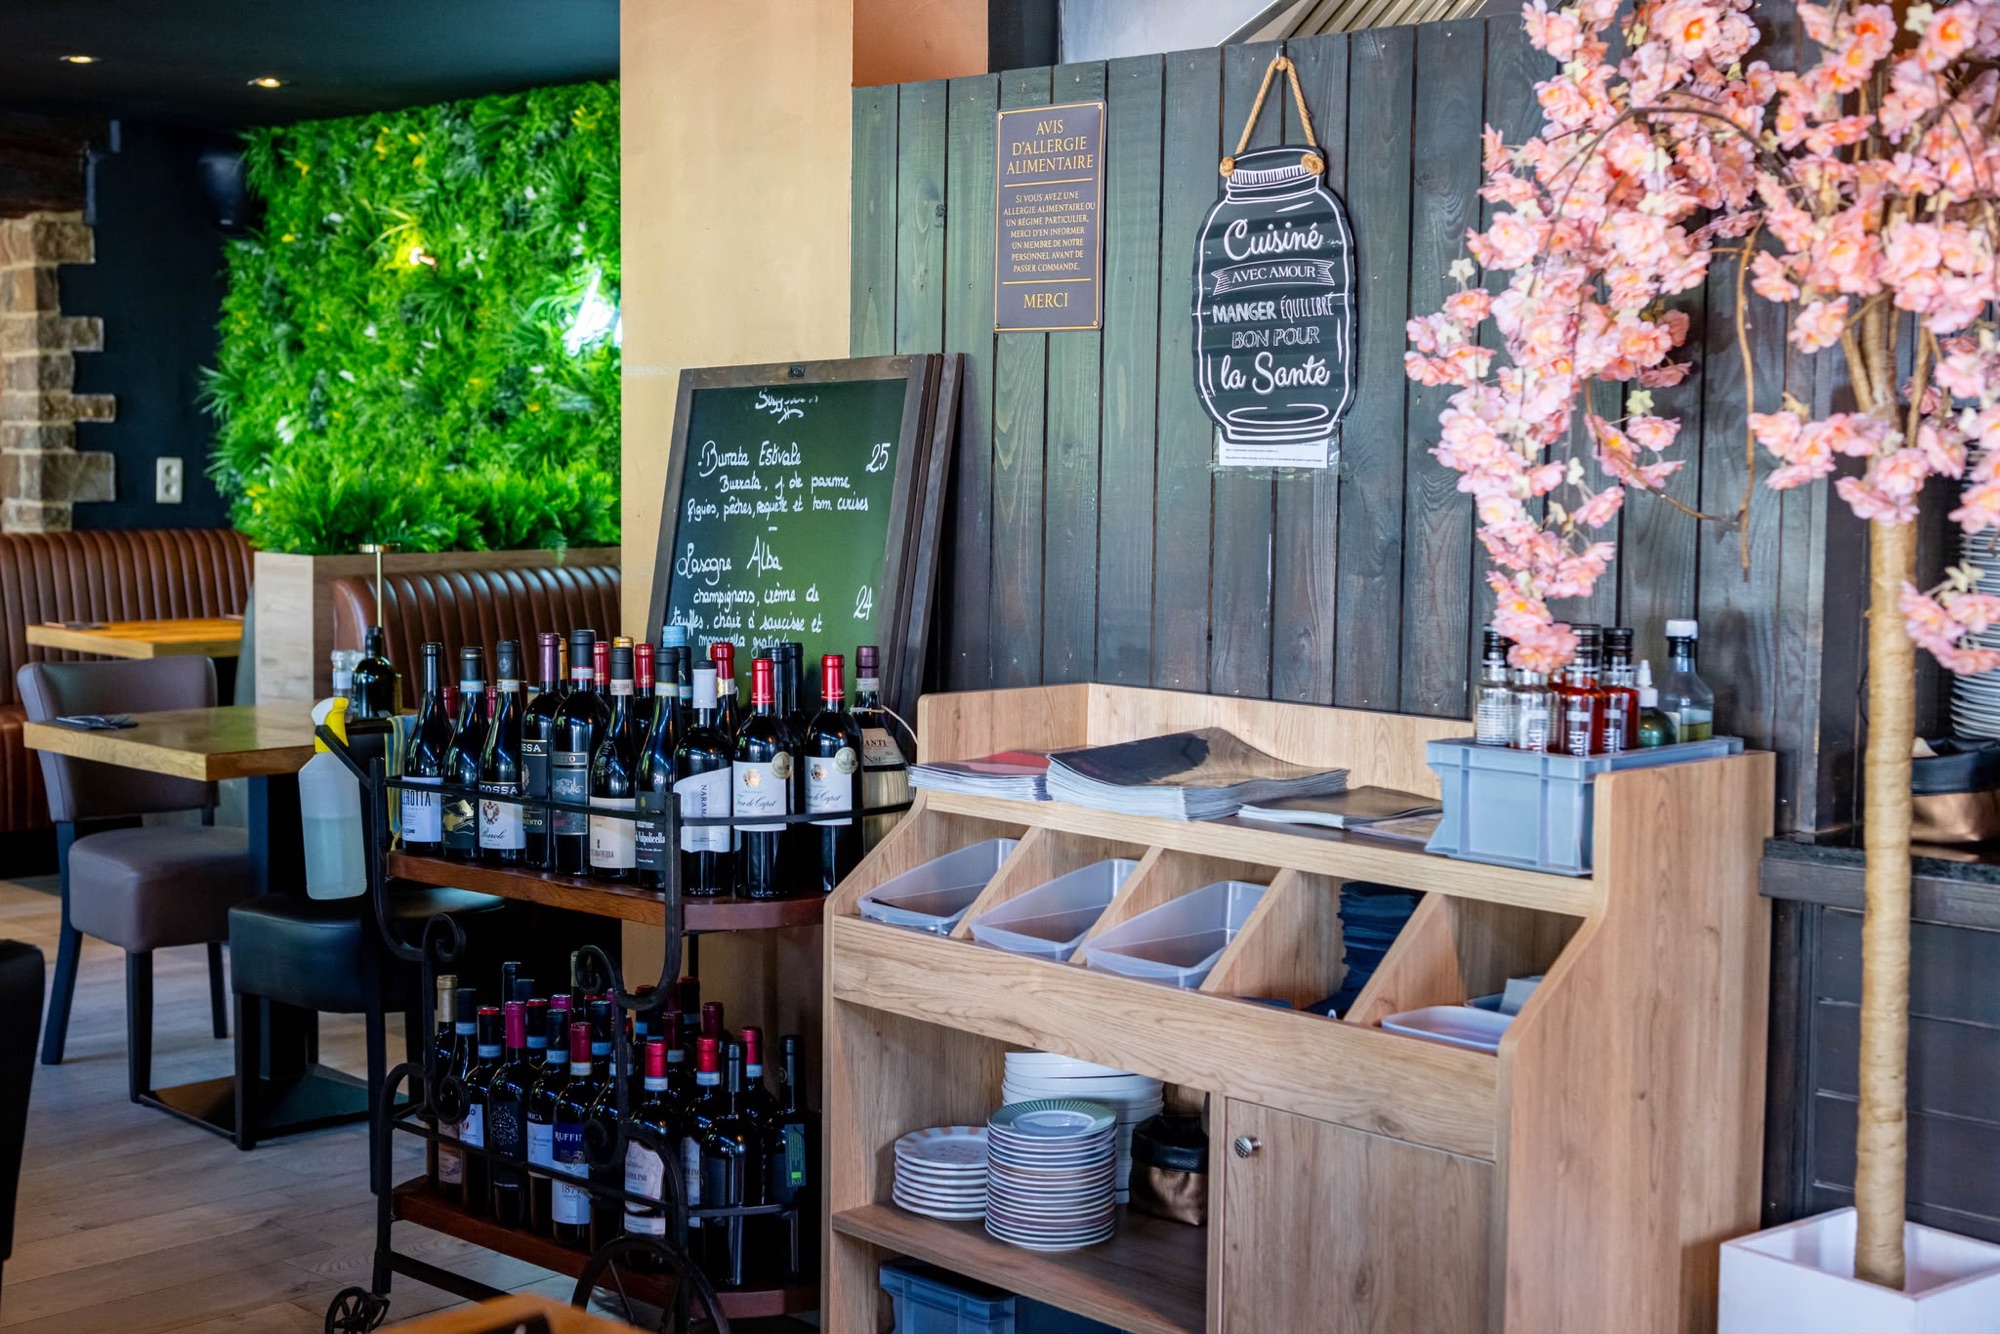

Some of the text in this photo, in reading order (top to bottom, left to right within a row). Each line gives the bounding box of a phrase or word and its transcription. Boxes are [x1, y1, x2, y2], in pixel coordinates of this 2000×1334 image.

[1035, 119, 1064, 136] AVIS
[1012, 136, 1087, 156] D'ALLERGIE
[1006, 154, 1094, 175] ALIMENTAIRE
[1015, 191, 1079, 203] SI VOUS AVEZ UNE
[1003, 202, 1096, 216] ALLERGIE ALIMENTAIRE OU
[1005, 214, 1090, 228] UN RÉGIME PARTICULIER,
[1010, 226, 1085, 238] MERCI D'EN INFORMER
[1223, 218, 1324, 261] Cuisiné
[1012, 238, 1084, 250] UN MEMBRE DE NOTRE
[1011, 250, 1084, 261] PERSONNEL AVANT DE
[1013, 262, 1080, 273] PASSER COMMANDE.
[1232, 265, 1316, 283] AVEC AMOUR
[1023, 292, 1069, 309] MERCI
[1212, 291, 1335, 324] MANGER ÉQUILIBRÉ
[1231, 325, 1321, 349] BON POUR
[1220, 351, 1331, 395] la Santé
[758, 440, 802, 467] Estivale
[865, 442, 892, 473] 25
[793, 494, 804, 512] et
[676, 535, 784, 586] Lasagne Alba
[852, 585, 873, 621] 24
[811, 612, 825, 634] et
[699, 784, 708, 820] NARAM
